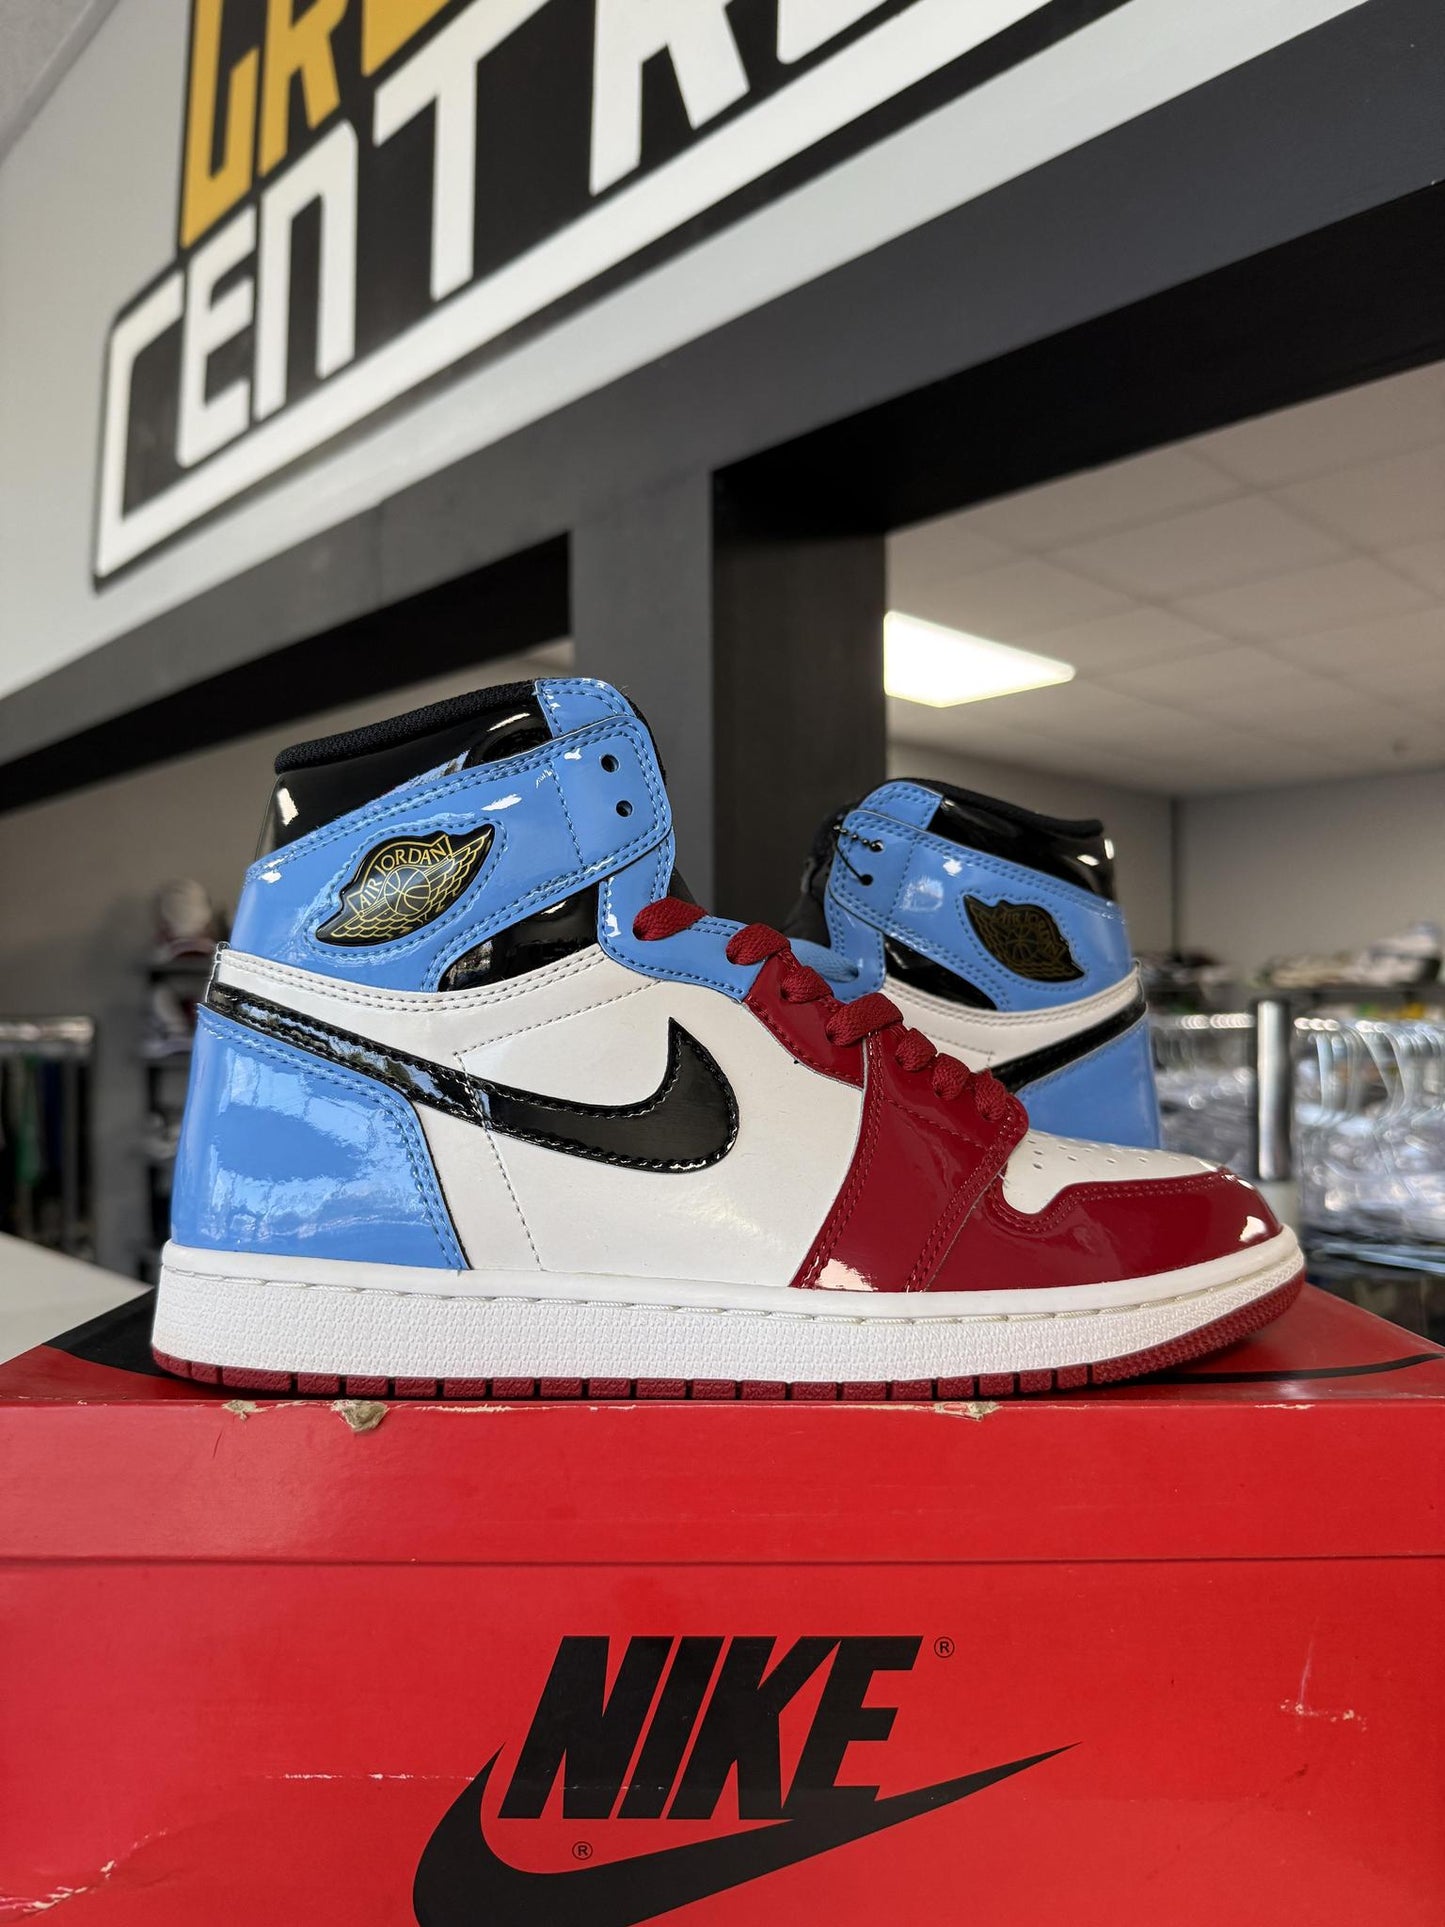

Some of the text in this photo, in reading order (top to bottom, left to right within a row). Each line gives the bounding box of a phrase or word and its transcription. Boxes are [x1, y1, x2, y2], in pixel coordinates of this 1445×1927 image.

[181, 0, 451, 249] CR
[94, 0, 890, 576] CENTR
[359, 842, 447, 909] AIR JORDAN
[497, 1635, 924, 1821] NIKE
